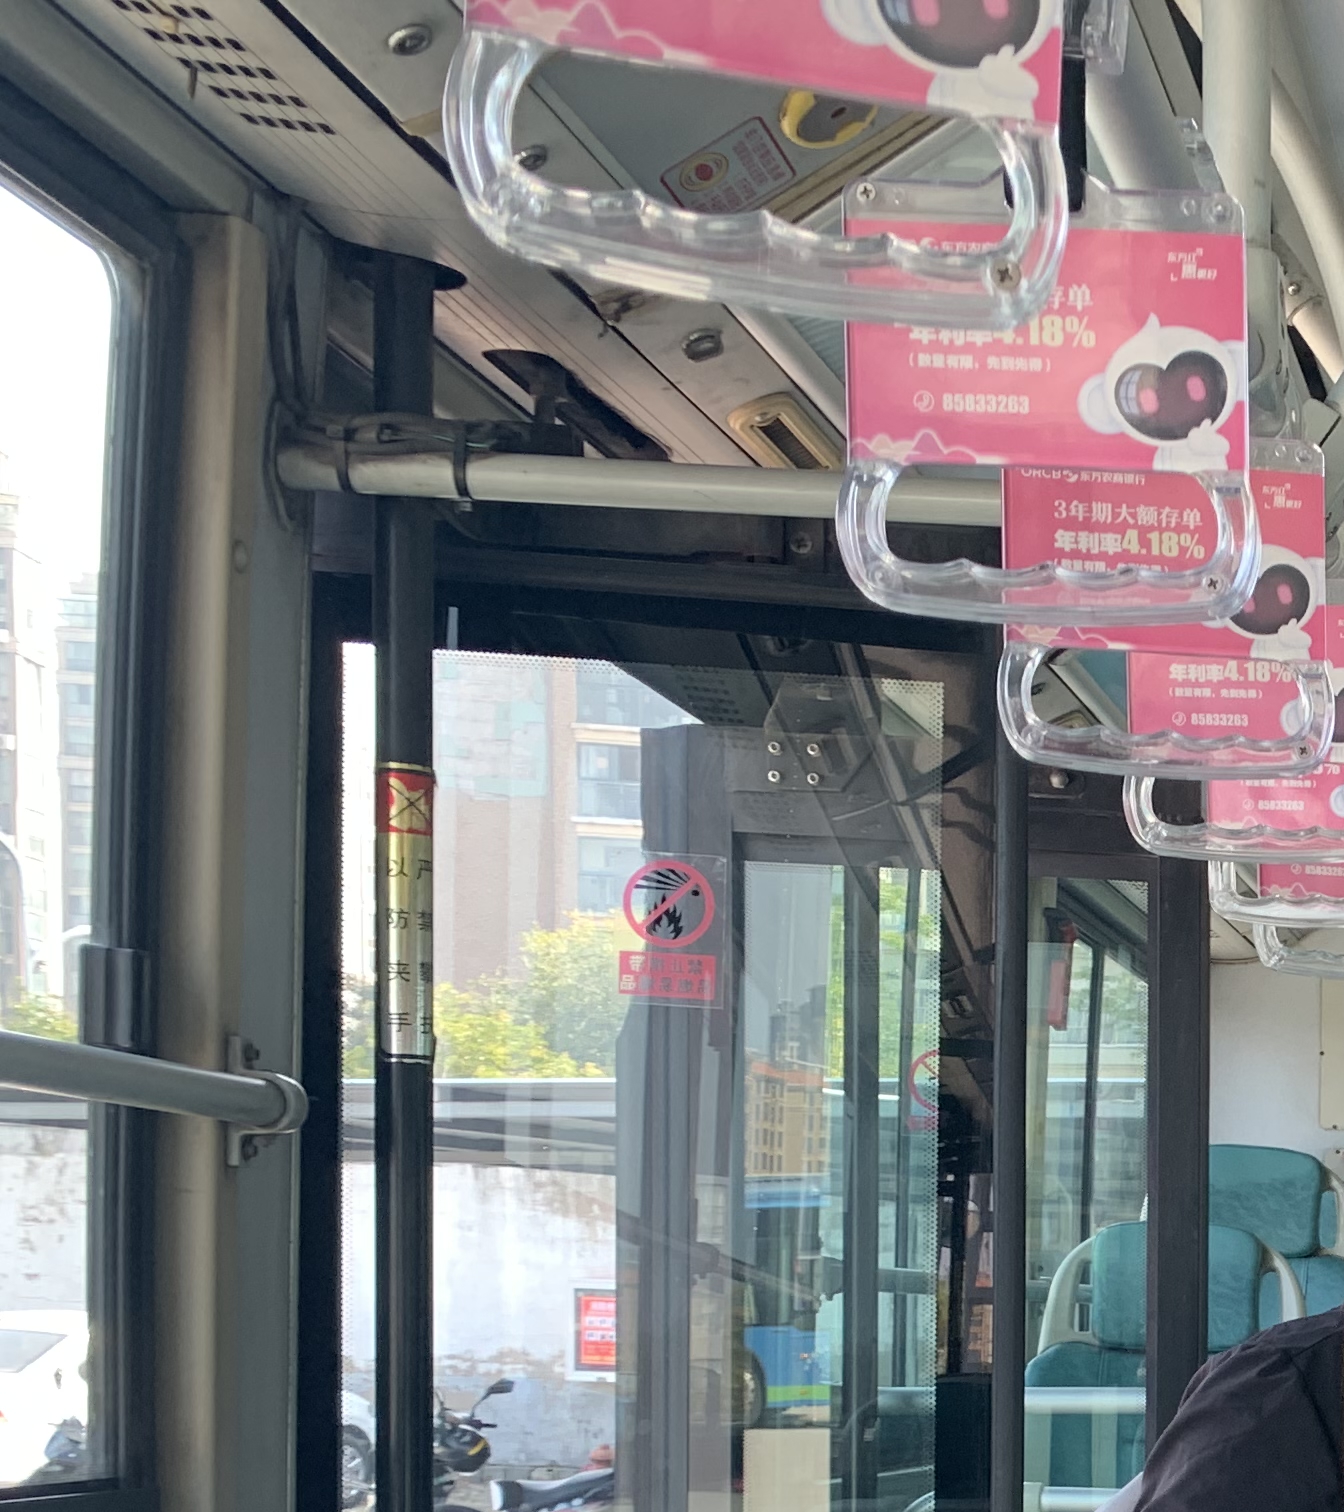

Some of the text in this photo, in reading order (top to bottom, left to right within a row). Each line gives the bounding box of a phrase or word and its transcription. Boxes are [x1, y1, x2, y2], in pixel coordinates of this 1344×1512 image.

[943, 393, 1030, 415] 85833263
[1054, 500, 1203, 530] 3年期大额存单
[1054, 529, 1205, 559] 年利率4.18%
[1169, 660, 1297, 683] 年利率4.18%
[1191, 713, 1249, 727] 85833263
